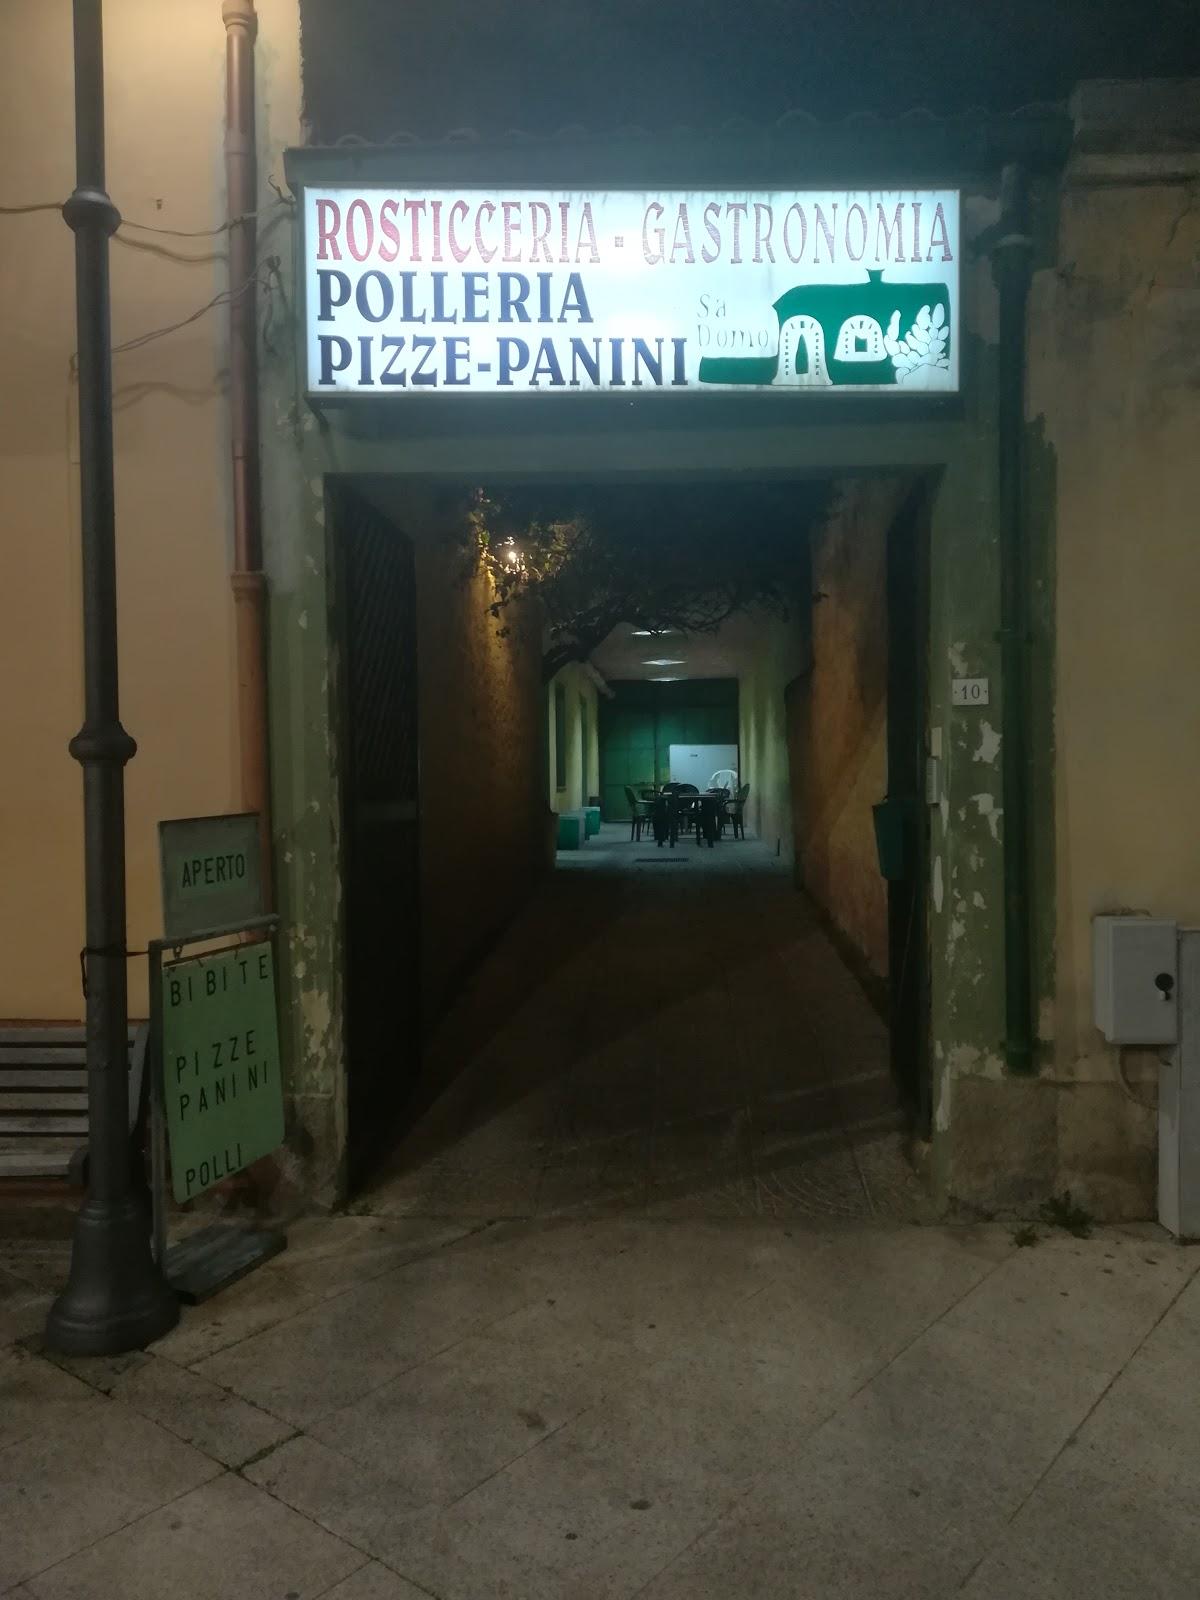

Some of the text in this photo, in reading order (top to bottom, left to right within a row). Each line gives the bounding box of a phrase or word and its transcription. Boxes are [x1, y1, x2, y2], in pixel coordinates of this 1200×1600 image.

[316, 199, 603, 264] ROSTICCERIA
[642, 201, 953, 264] GASTRONOMIA
[316, 270, 593, 323] POLLERIA
[696, 293, 727, 318] Sa
[316, 336, 689, 387] PIZZE-PANINI
[182, 853, 246, 888] APERTO
[171, 953, 269, 1006] BIBITE
[176, 1030, 256, 1084] PIZZE
[180, 1060, 269, 1120] PANINI
[185, 1143, 243, 1196] POLLI
